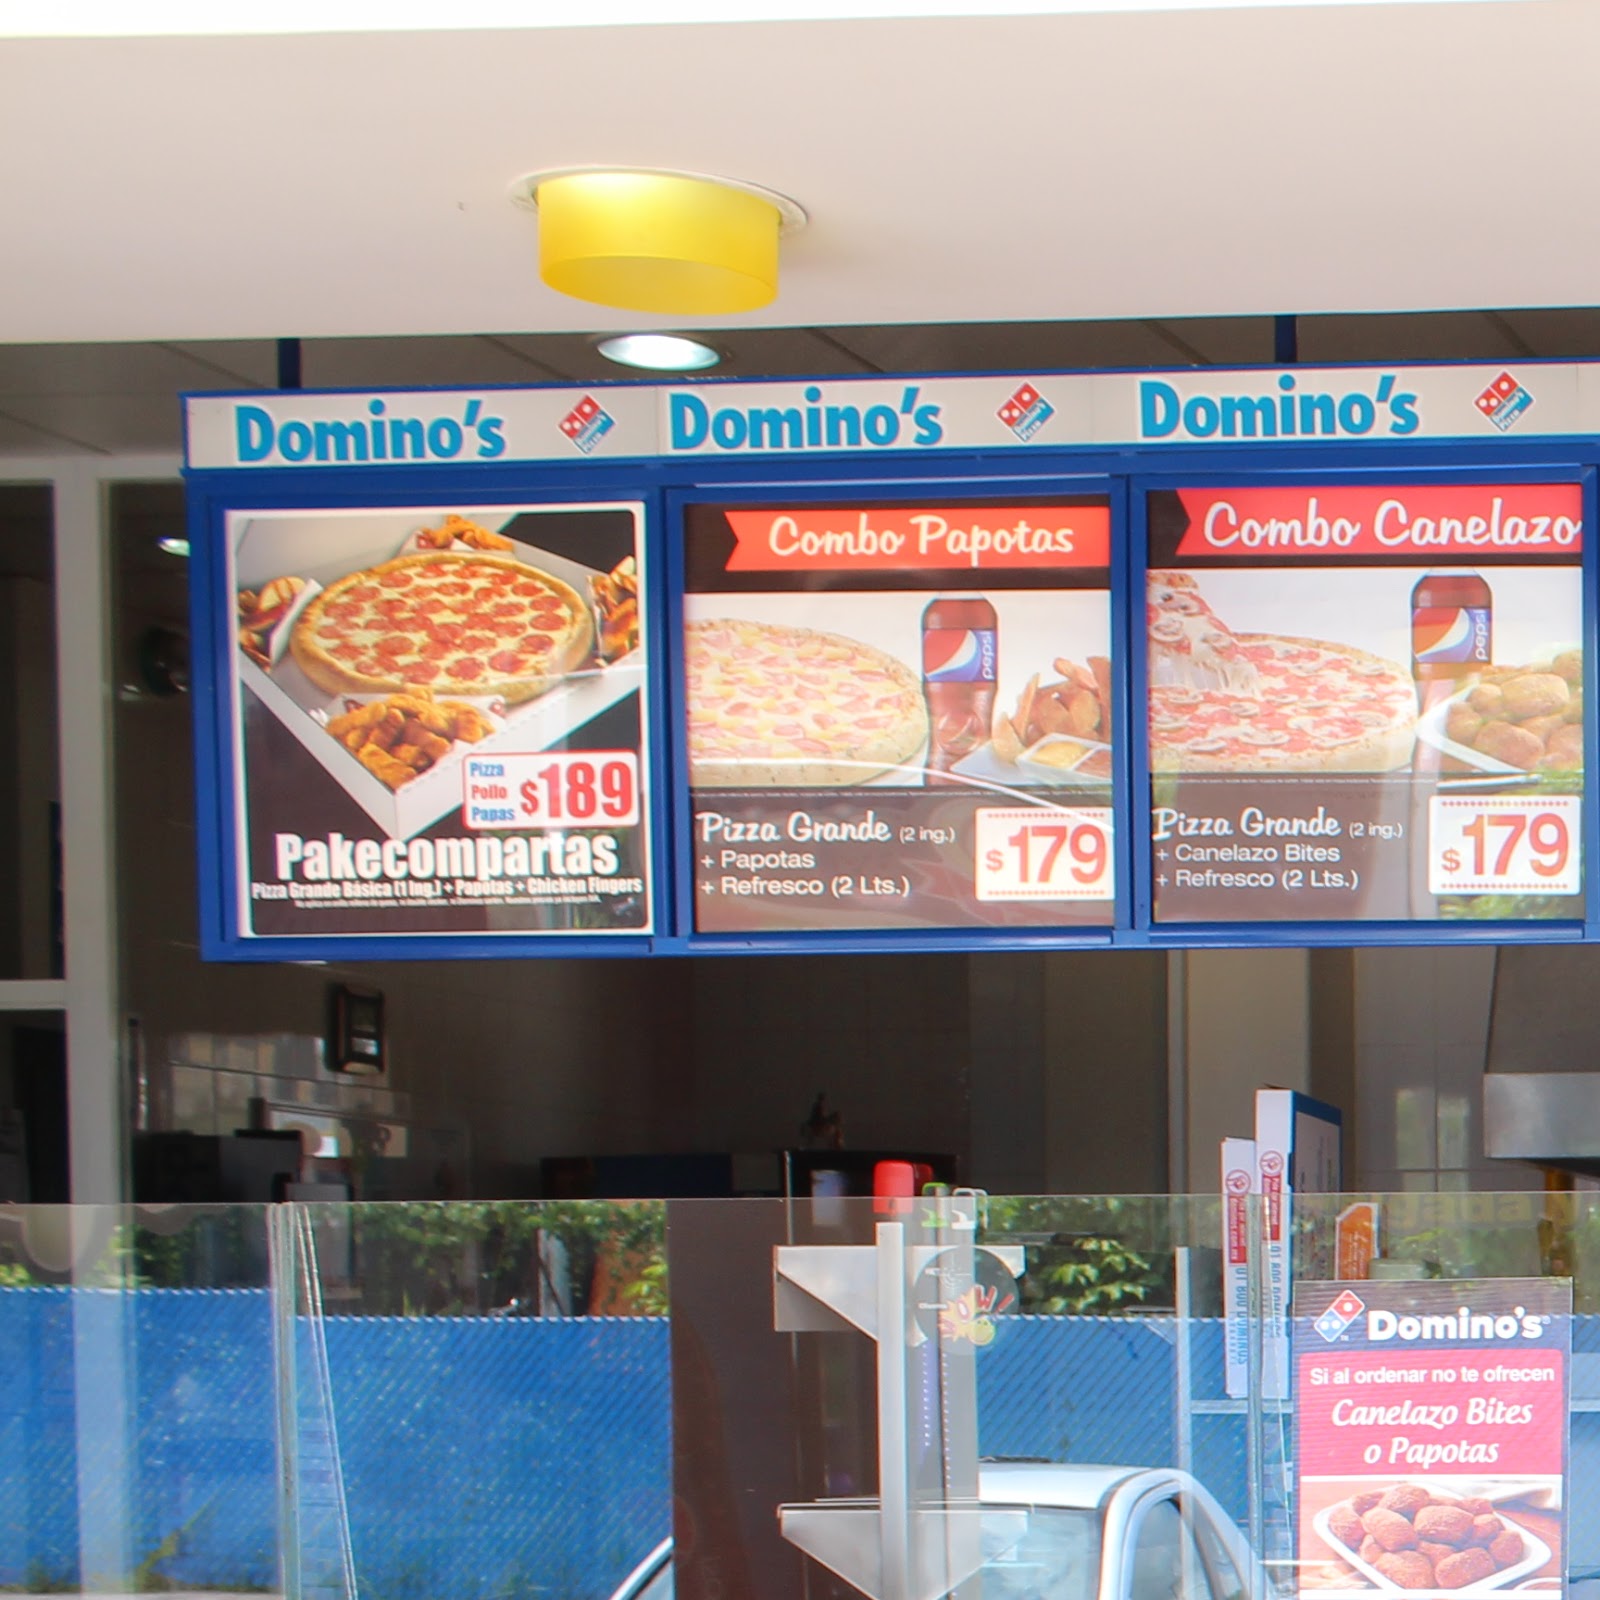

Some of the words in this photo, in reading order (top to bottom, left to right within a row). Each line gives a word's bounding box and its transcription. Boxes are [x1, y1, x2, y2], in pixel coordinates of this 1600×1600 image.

[670, 386, 943, 449] Domino's
[1139, 374, 1419, 437] Domino's
[234, 399, 506, 462] Domino's
[1203, 496, 1360, 548] Combo
[1374, 497, 1582, 546] Canelazo
[769, 513, 905, 556] Combo
[909, 514, 1075, 568] Papotas
[1474, 609, 1487, 660] pepsi
[982, 631, 995, 680] pepsi
[470, 762, 504, 777] Pizza
[471, 784, 507, 800] Pollo
[520, 761, 633, 819] $189
[471, 806, 515, 822] Papas
[695, 811, 781, 844] Pizza
[787, 810, 892, 842] Grande
[899, 827, 915, 843] (2
[919, 827, 956, 843] ing.)
[1151, 807, 1233, 841] Pizza
[1240, 806, 1342, 838] Grande
[1349, 822, 1365, 839] (2
[1368, 822, 1404, 840] ing.)
[276, 832, 619, 880] Pakecompartas
[701, 854, 714, 867] +
[720, 850, 815, 872] Papotas
[986, 823, 1108, 885] $179
[1156, 849, 1169, 861] +
[1175, 845, 1279, 863] Canelazo
[1285, 845, 1341, 863] Bites
[1441, 812, 1570, 877] $179
[252, 882, 287, 899] Pizza
[289, 881, 341, 898] Grande
[455, 879, 514, 896] Papotas
[527, 878, 586, 894] Chicken
[588, 877, 643, 894] Fingers
[701, 881, 714, 894] +
[720, 876, 824, 896] Refresco
[831, 876, 853, 898] (2
[859, 876, 910, 898] Lts.)
[1156, 874, 1169, 887] +
[1175, 869, 1275, 888] Refresco
[1281, 869, 1303, 890] (2
[1310, 869, 1359, 890] Lts.)
[1368, 1306, 1545, 1341] Domino's
[1310, 1366, 1329, 1385] Si
[1333, 1366, 1350, 1384] al
[1354, 1366, 1427, 1385] ordenar
[1432, 1369, 1455, 1383] no
[1460, 1367, 1479, 1383] te
[1484, 1364, 1555, 1382] ofrecen
[1332, 1398, 1459, 1430] Canelazo
[1466, 1397, 1533, 1426] Bites
[1364, 1446, 1381, 1464] o
[1388, 1436, 1499, 1469] Papotas
